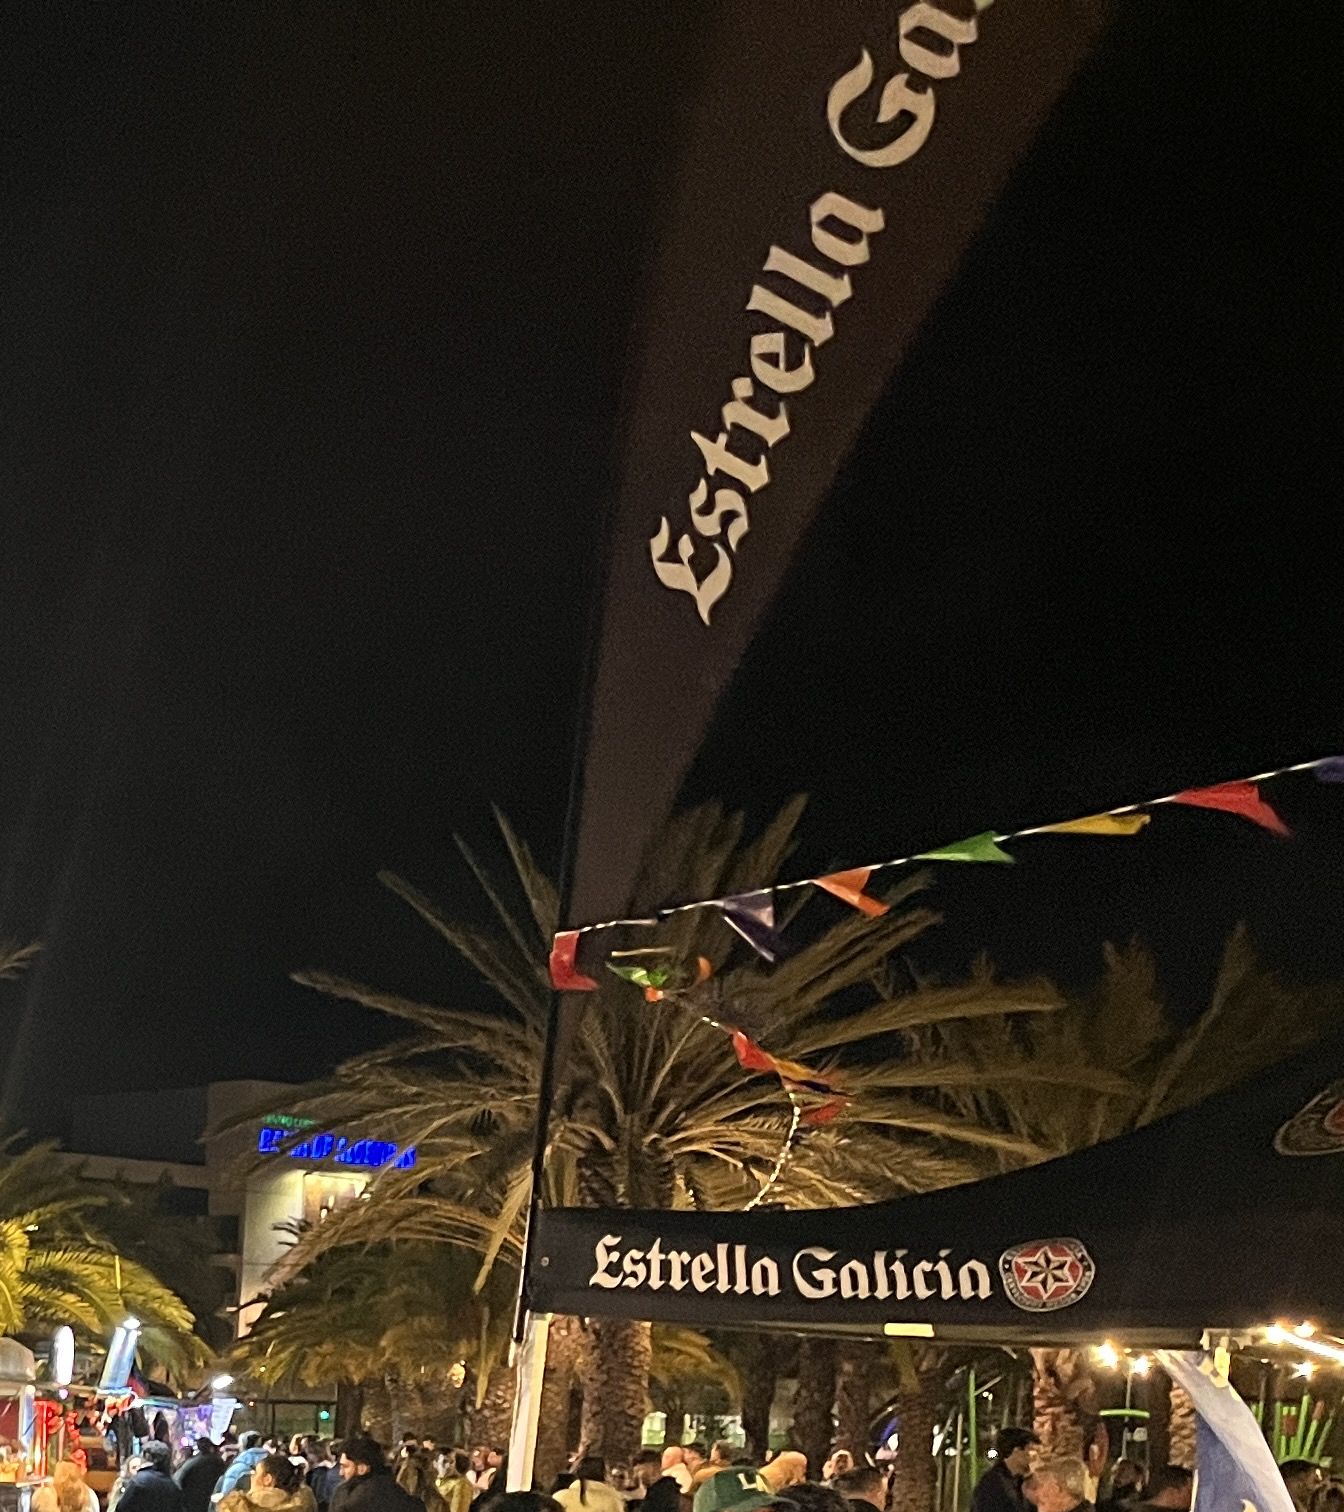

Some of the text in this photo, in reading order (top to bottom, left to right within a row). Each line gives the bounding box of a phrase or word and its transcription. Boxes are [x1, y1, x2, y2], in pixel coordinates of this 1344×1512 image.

[650, 0, 994, 625] Estrella Ga
[588, 1234, 781, 1296] Estrella
[792, 1246, 993, 1300] Galicia
